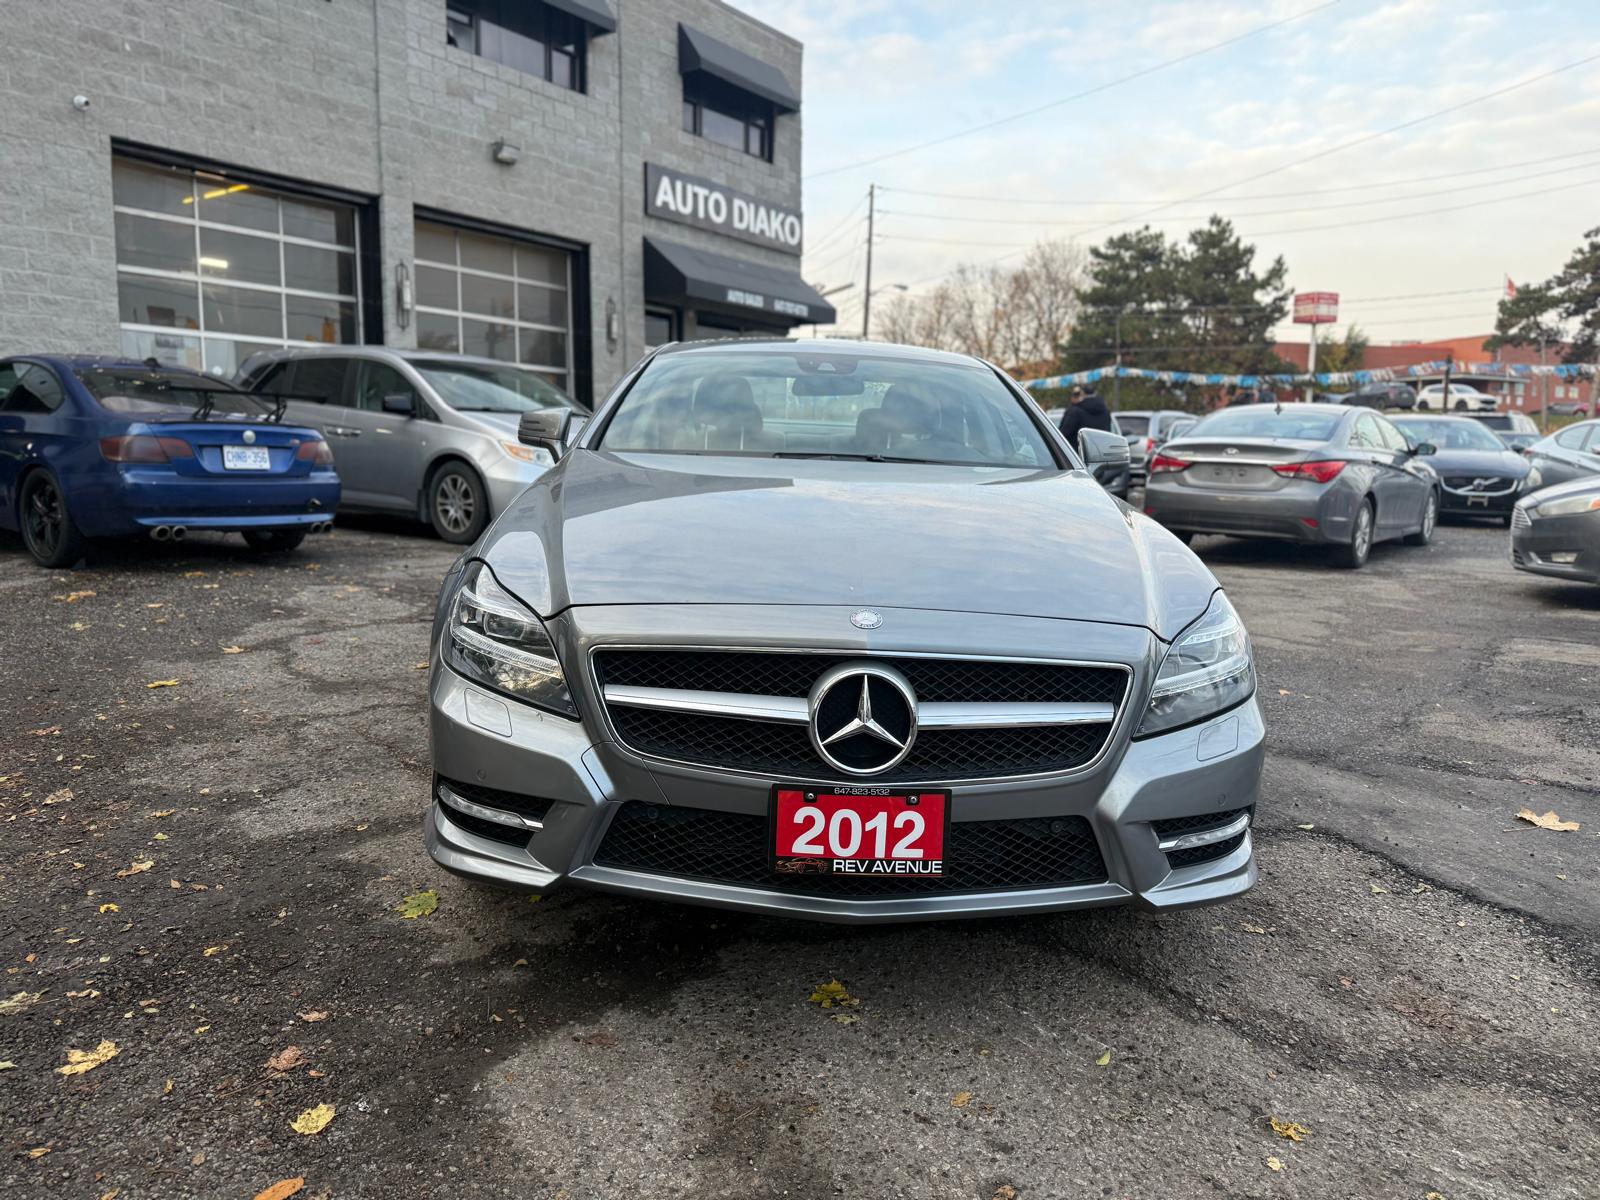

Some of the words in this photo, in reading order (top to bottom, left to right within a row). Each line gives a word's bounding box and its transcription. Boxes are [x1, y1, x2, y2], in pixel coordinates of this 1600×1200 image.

[655, 175, 727, 224] AUTO
[732, 198, 801, 246] DIAKO
[833, 787, 891, 796] 647-823-5132
[791, 806, 926, 859] 2012
[833, 859, 870, 873] REV
[871, 860, 943, 874] AVENUE
